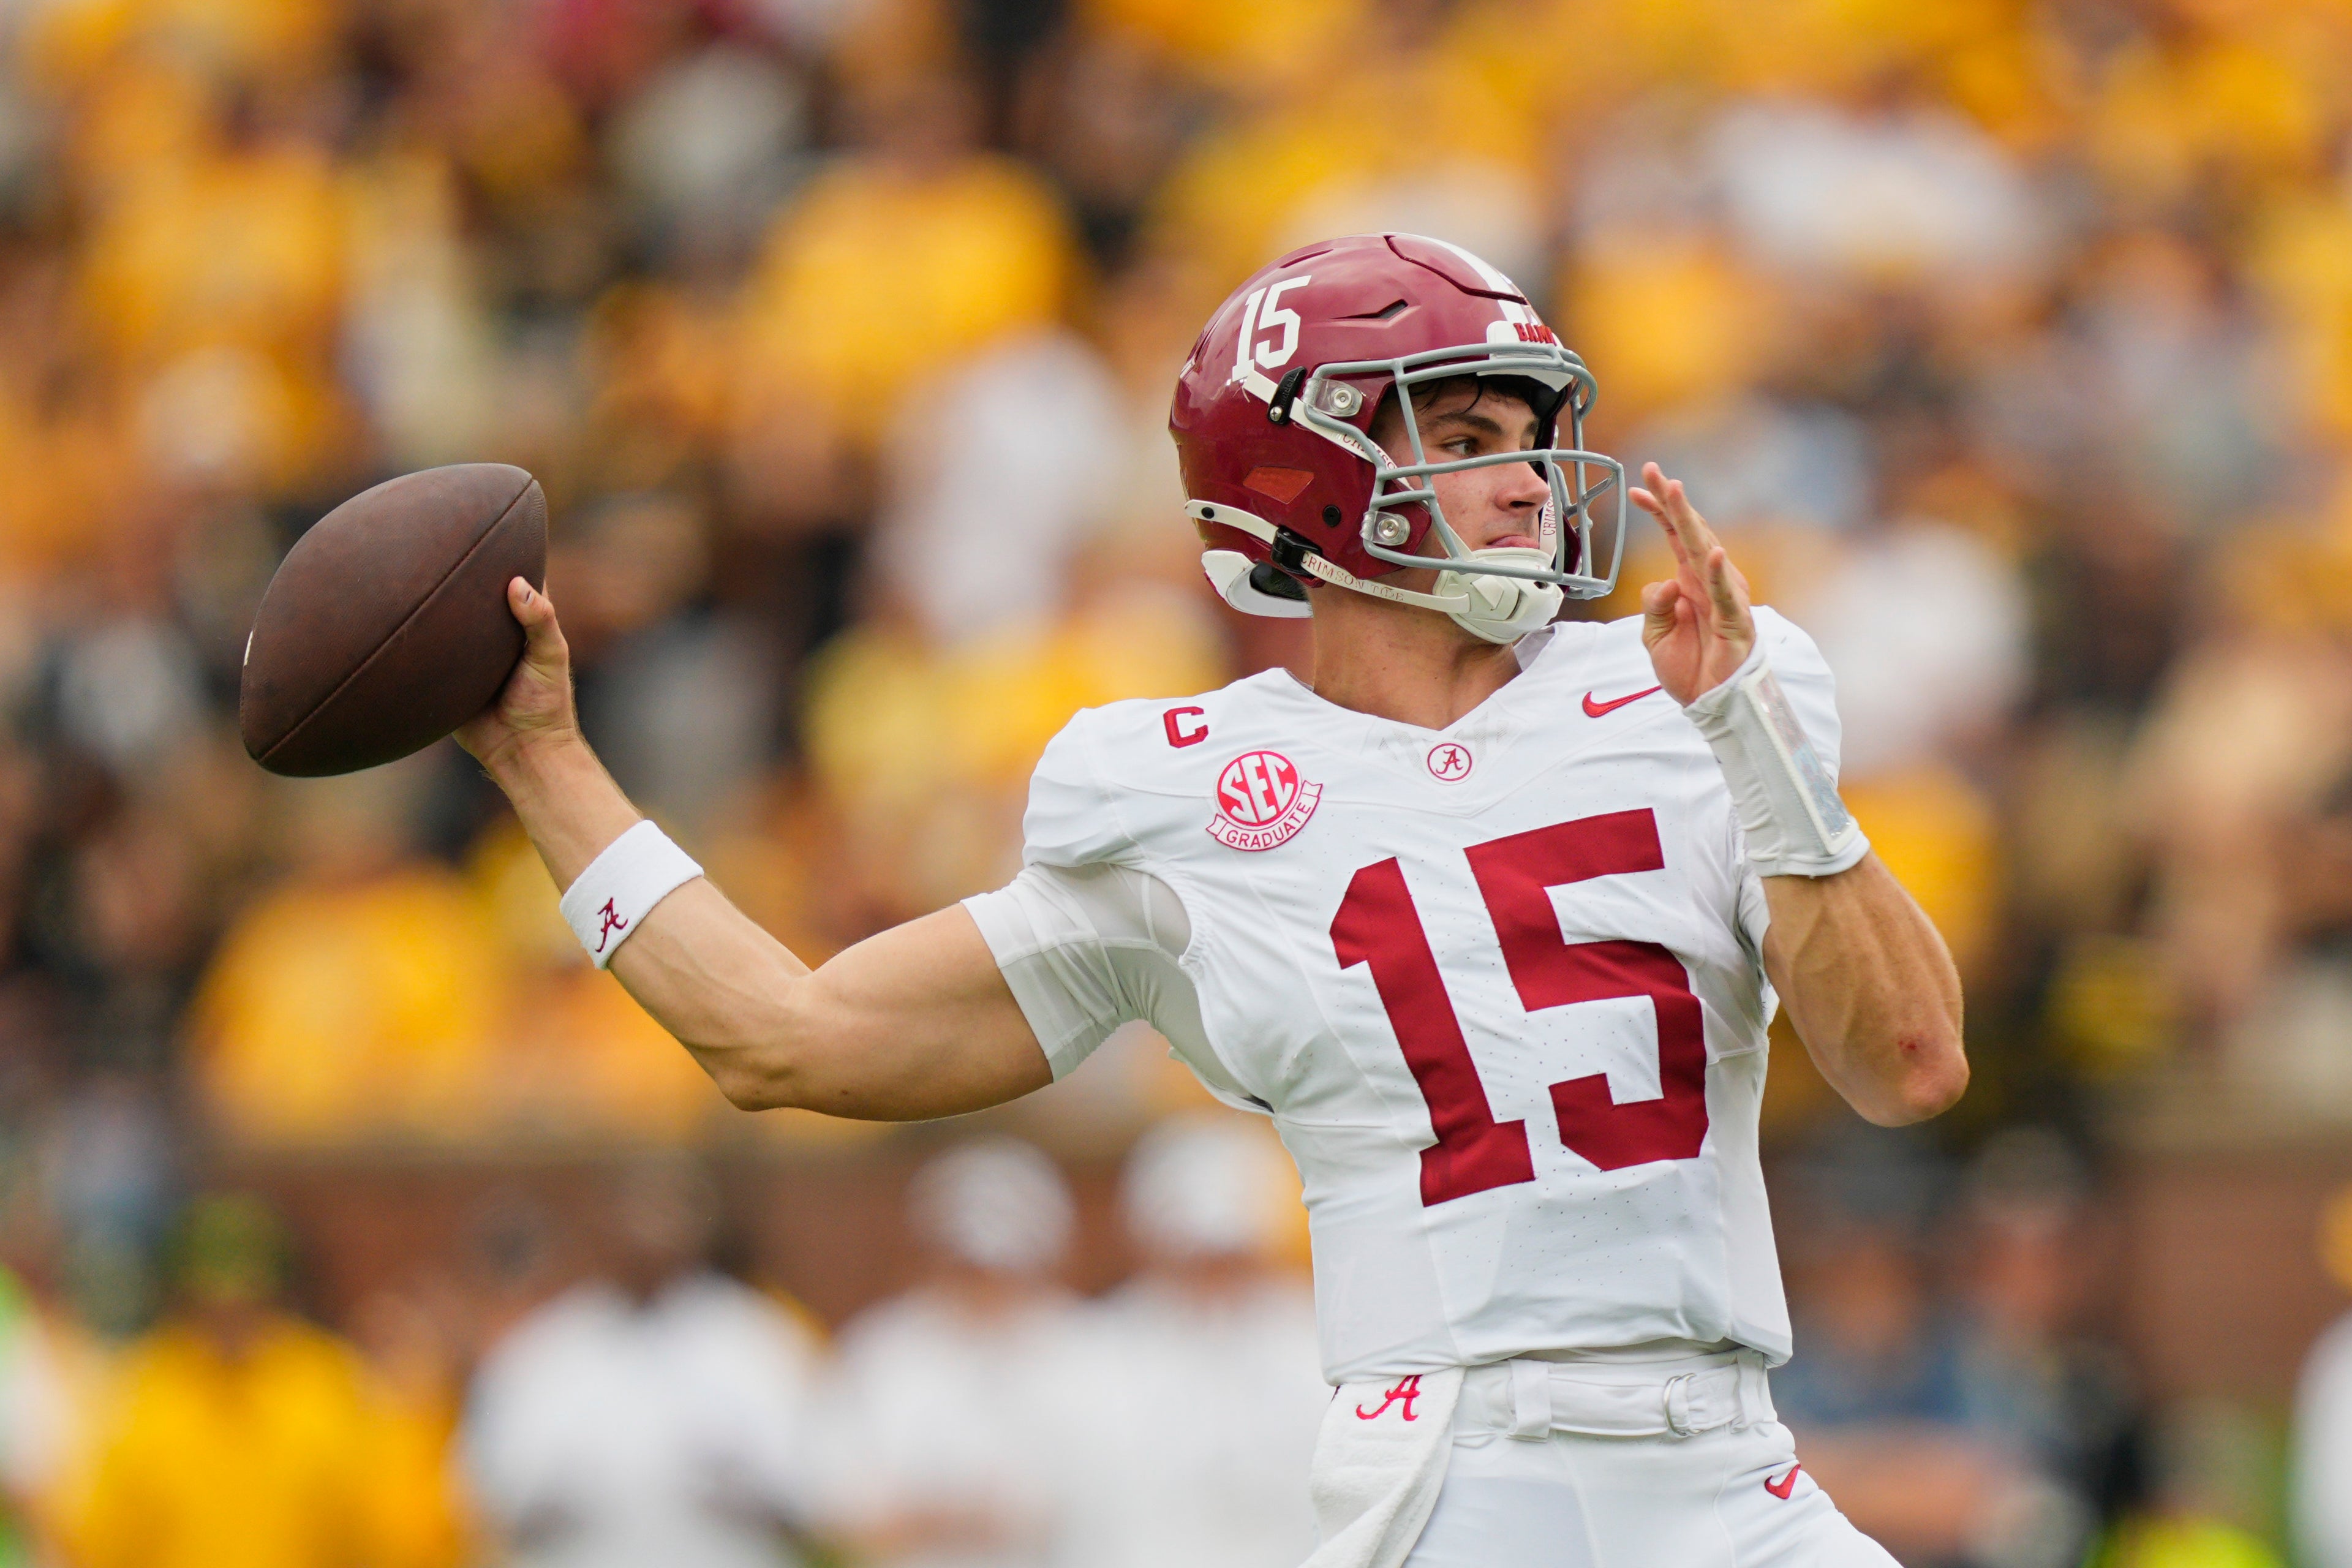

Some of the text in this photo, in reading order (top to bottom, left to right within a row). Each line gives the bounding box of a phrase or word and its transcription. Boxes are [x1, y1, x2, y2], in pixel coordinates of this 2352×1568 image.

[1232, 275, 1312, 382] 15
[1513, 323, 1557, 346] BAM
[1163, 706, 1208, 748] C
[1436, 747, 1464, 774] A
[1220, 753, 1294, 823] SEC
[1226, 801, 1311, 848] GRADUATE
[595, 897, 628, 952] A
[1329, 807, 1709, 1207] 15
[1355, 1374, 1423, 1421] A
